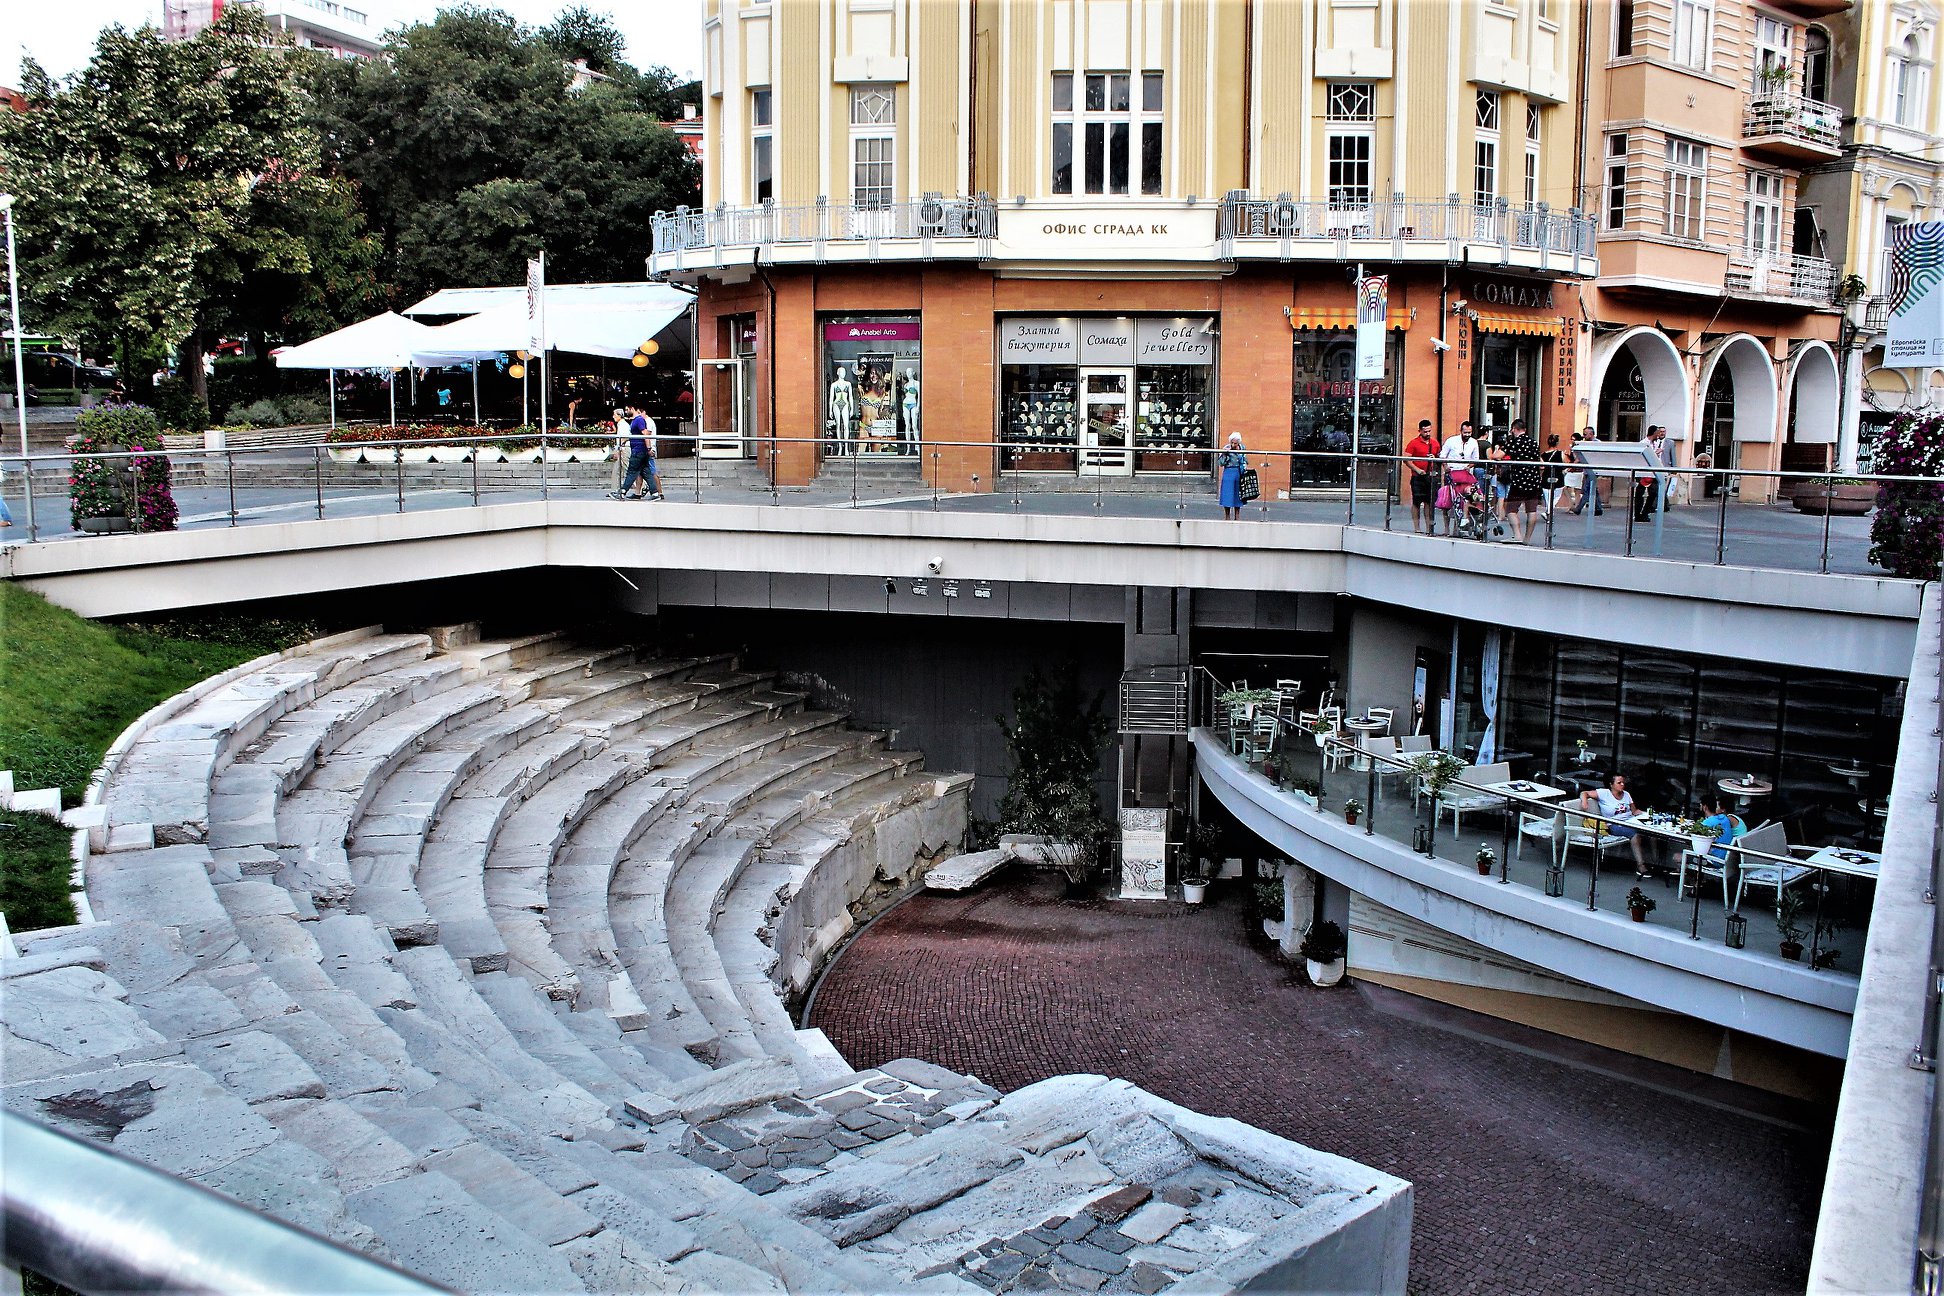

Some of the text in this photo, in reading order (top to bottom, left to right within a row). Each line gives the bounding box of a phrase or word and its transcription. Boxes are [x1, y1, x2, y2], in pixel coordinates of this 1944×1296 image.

[1042, 223, 1168, 236] ОФИС СГРАДА КК
[1473, 282, 1554, 309] СОМАХА
[1018, 326, 1060, 336] Златна
[1161, 327, 1195, 340] Gold
[1008, 338, 1071, 354] бижутерия
[1087, 335, 1128, 347] Сомаха
[1143, 341, 1209, 355] jewellery
